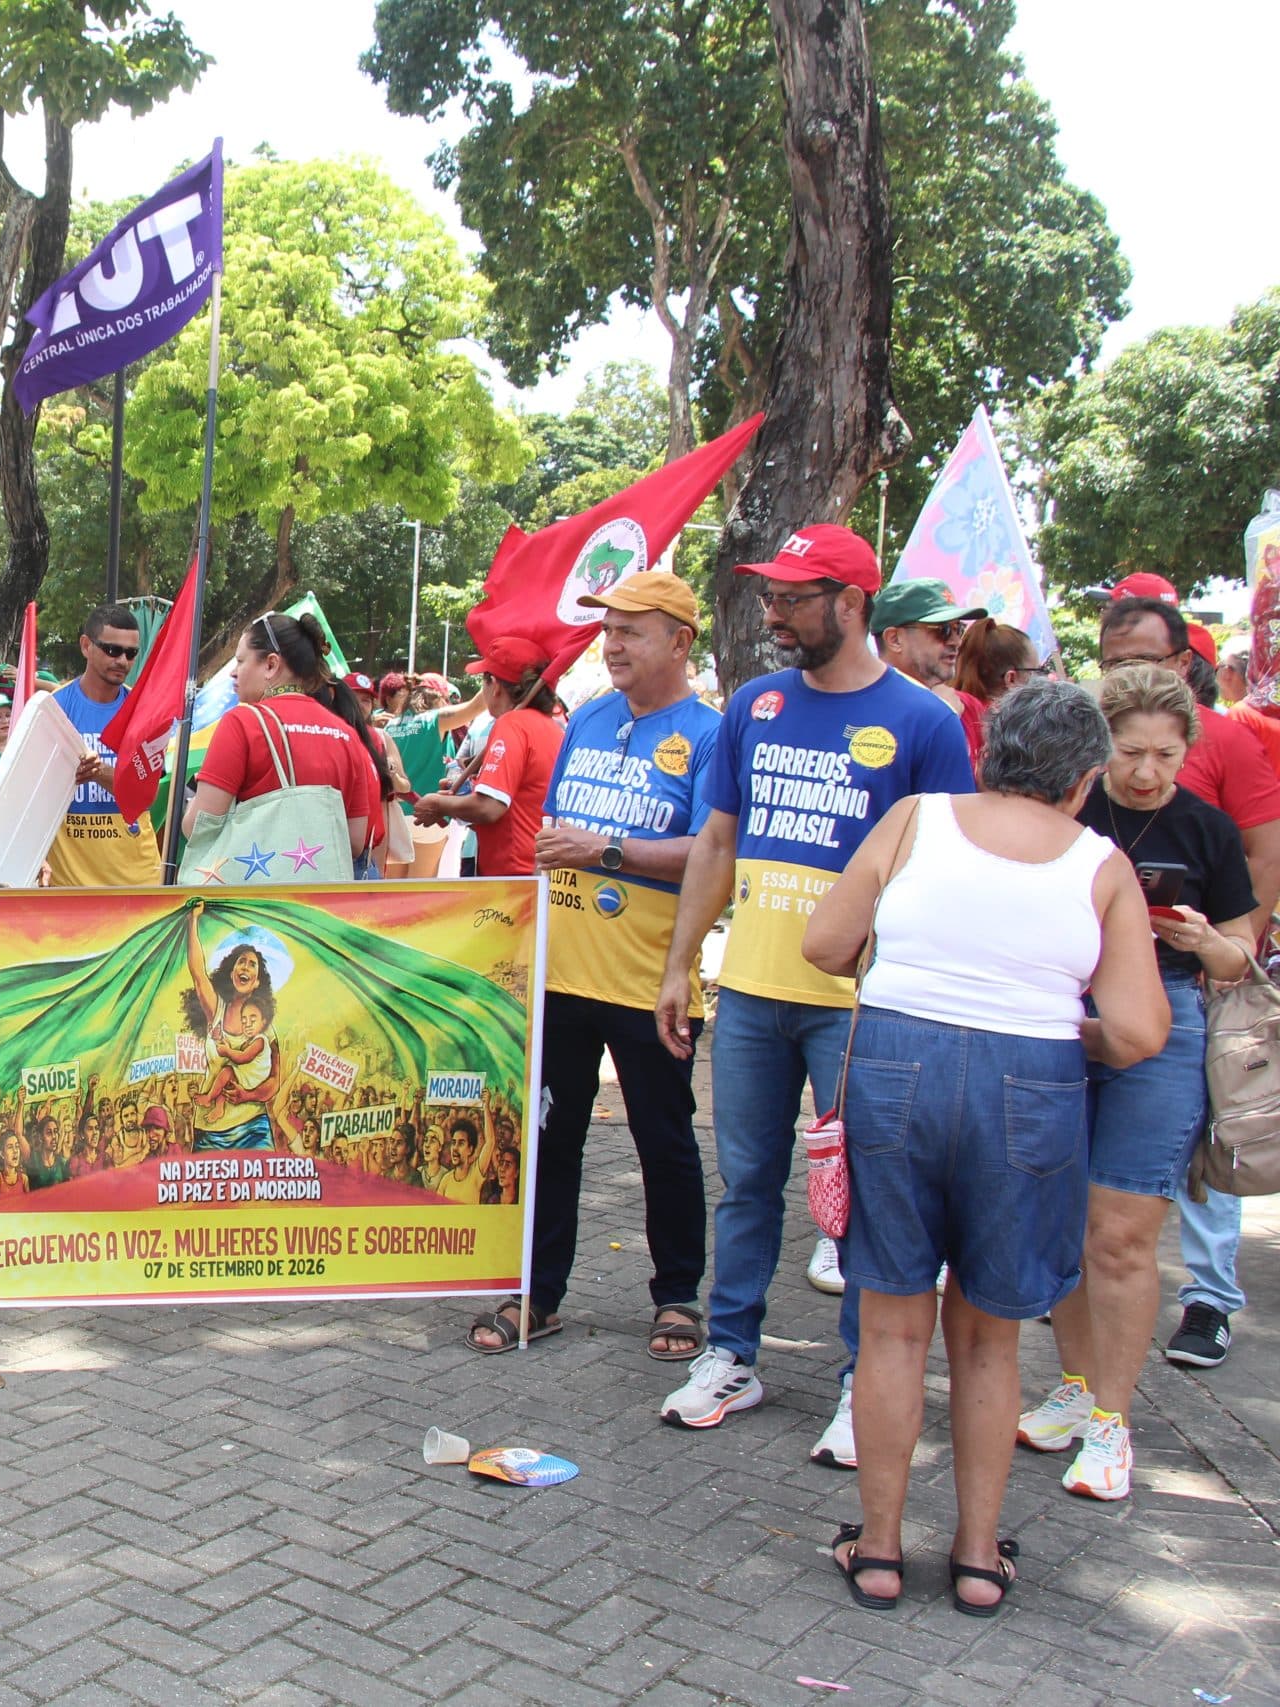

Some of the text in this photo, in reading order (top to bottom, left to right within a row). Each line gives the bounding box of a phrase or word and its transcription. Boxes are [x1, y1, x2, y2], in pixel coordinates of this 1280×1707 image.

[23, 261, 213, 374] CENTRAL ÚNICA DOS TRABALHADOR
[752, 742, 852, 786] CORREIOS,
[751, 773, 870, 820] PATRIMÔNIO
[66, 815, 113, 825] ESSA LUTA
[767, 809, 840, 849] BRASIL.
[73, 829, 85, 838] DE
[88, 829, 122, 839] TODOS.
[761, 871, 835, 895] ESSA LUT
[549, 889, 585, 911] ODOS.
[759, 890, 768, 909] É
[771, 894, 791, 912] DE
[130, 1056, 174, 1081] DEMOCRACIA
[304, 1056, 353, 1091] BASTA!
[310, 1047, 355, 1077] VIOLÊNCIA
[27, 1066, 76, 1096] SAÚDE
[428, 1077, 481, 1099] MORADIA
[323, 1112, 393, 1141] TRABALHO
[160, 1157, 319, 1181] NA DEFESA DA TERRA,
[158, 1180, 321, 1203] DA PAZ E DA MORADIA
[106, 1231, 118, 1261] A
[123, 1229, 168, 1260] VOZ:
[174, 1227, 278, 1257] MULHERES
[284, 1226, 342, 1256] VIVAS
[347, 1227, 360, 1255] E
[364, 1226, 477, 1256] SOBERANIA!
[144, 1258, 326, 1279] 07 DE SETEMBRO DE 2026
